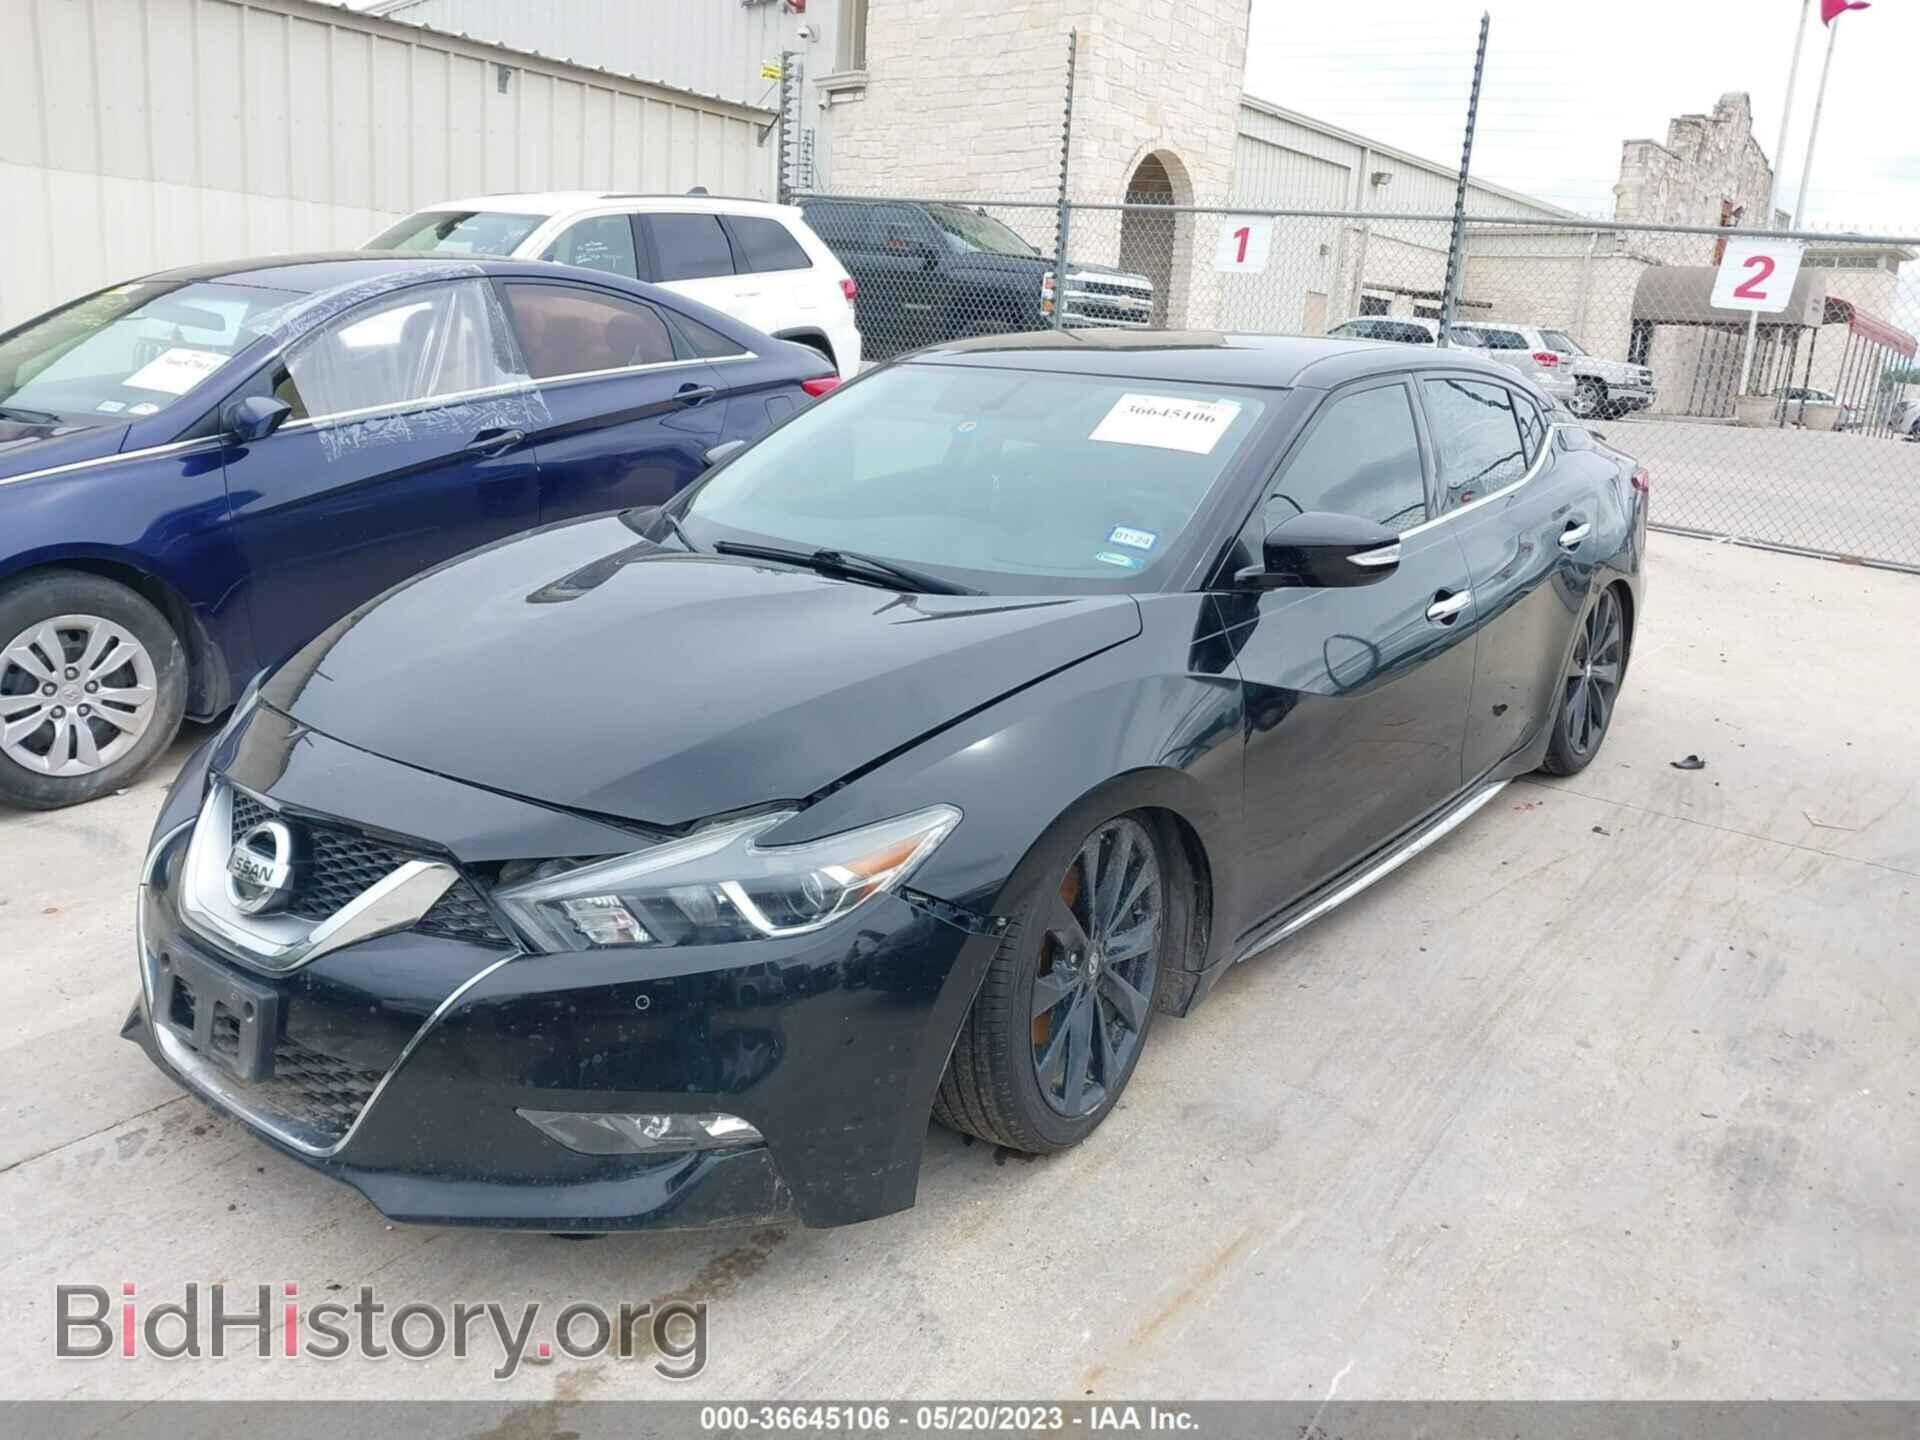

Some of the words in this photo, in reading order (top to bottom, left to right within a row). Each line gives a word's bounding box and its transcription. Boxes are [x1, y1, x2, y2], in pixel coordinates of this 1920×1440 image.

[1233, 226, 1250, 263] 1
[1733, 255, 1775, 300] 2
[226, 848, 275, 882] ISSAN
